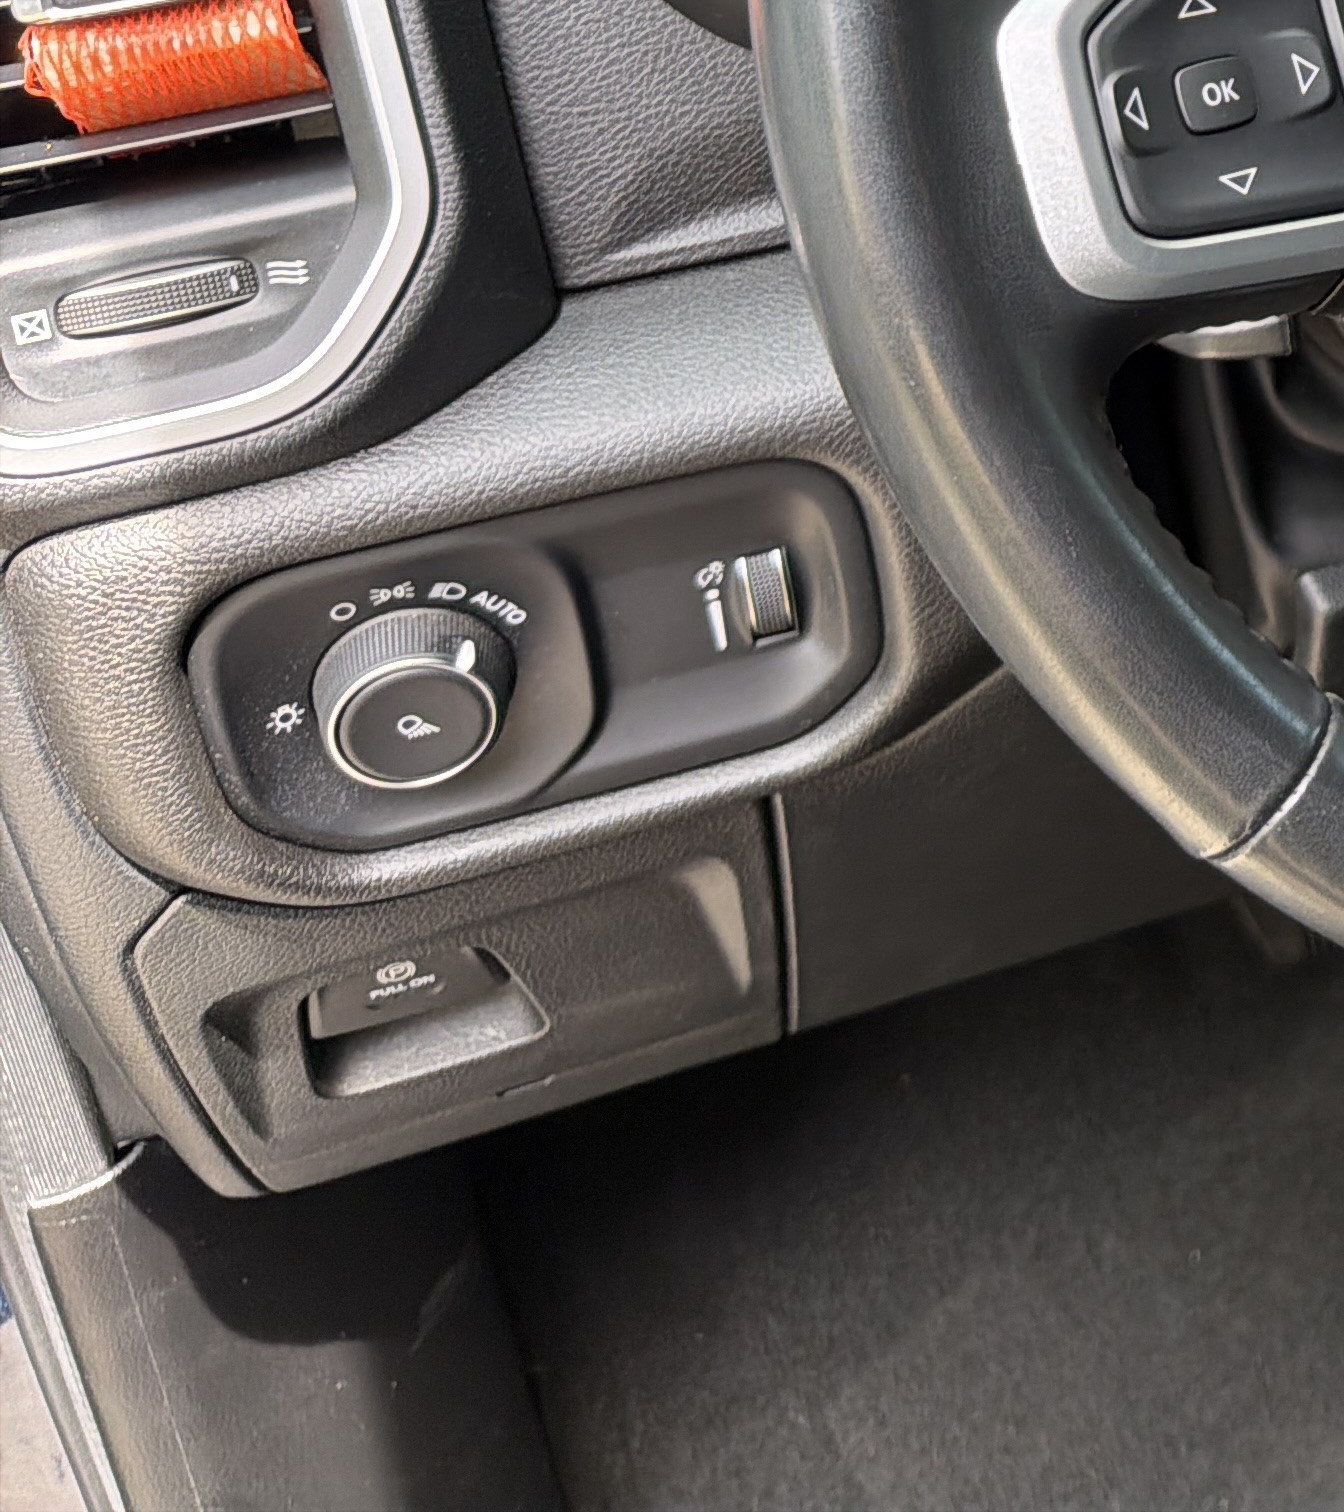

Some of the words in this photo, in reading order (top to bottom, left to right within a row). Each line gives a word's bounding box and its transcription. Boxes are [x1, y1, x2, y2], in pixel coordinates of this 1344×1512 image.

[1201, 77, 1241, 107] OK
[469, 590, 527, 625] AUTO
[369, 983, 408, 1000] PULL
[409, 974, 435, 988] ON
